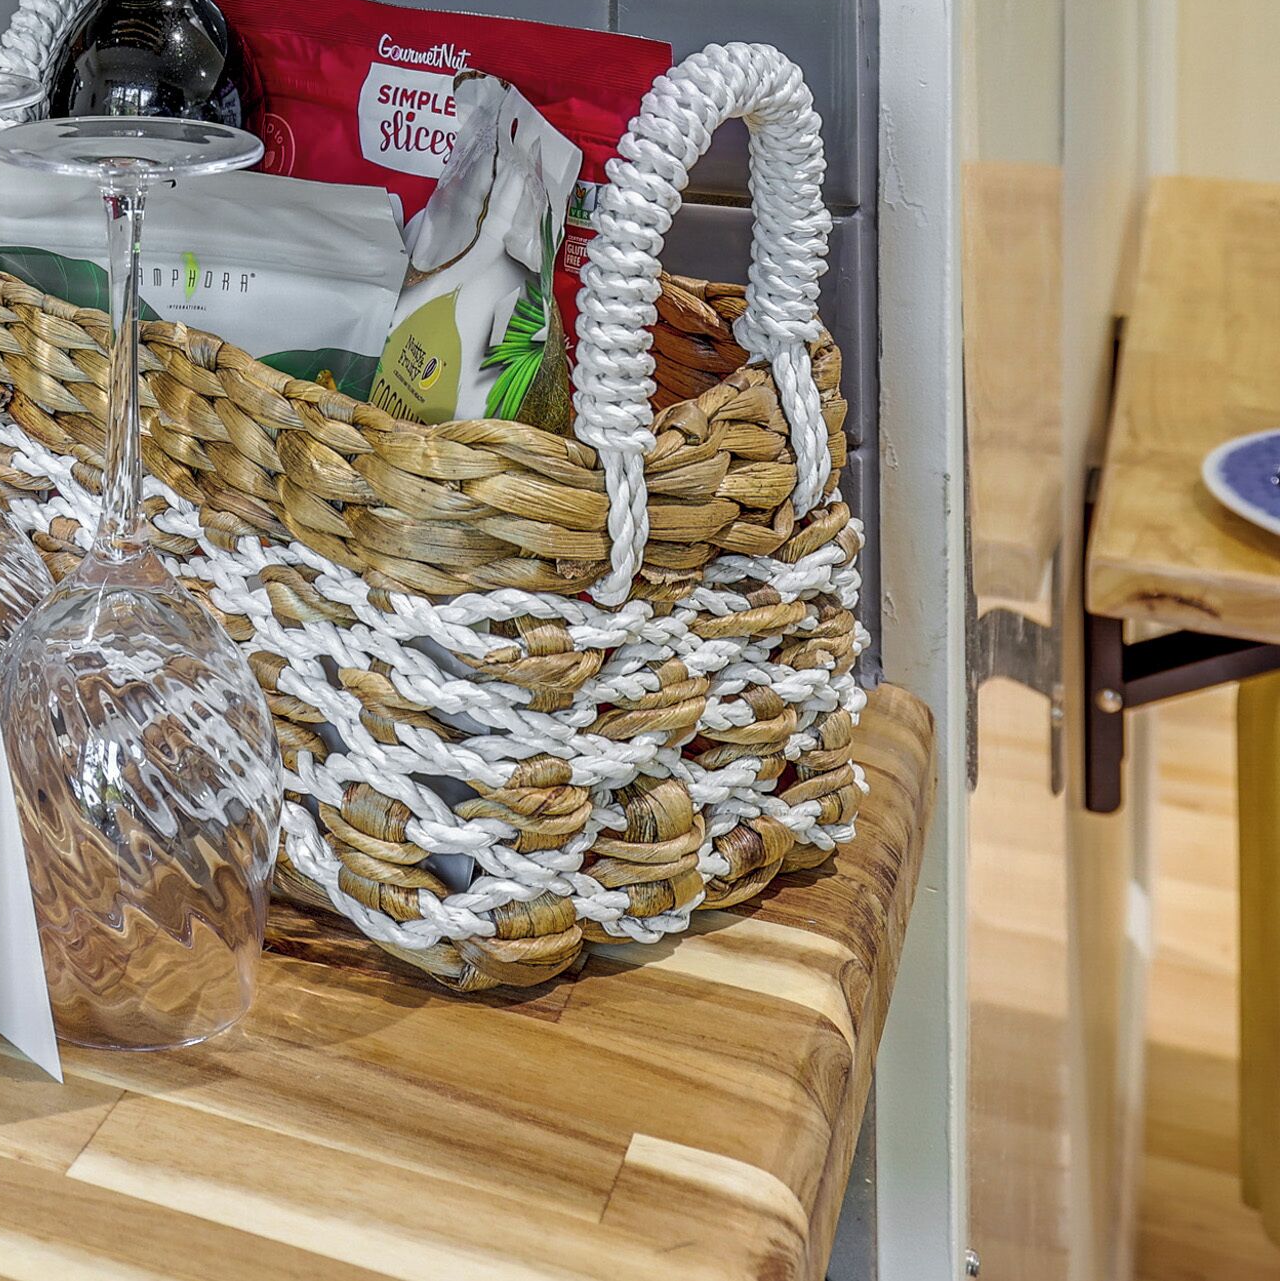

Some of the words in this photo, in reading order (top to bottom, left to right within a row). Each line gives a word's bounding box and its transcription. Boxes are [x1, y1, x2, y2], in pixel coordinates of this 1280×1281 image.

[377, 84, 456, 117] SIMPLE
[380, 110, 457, 164] slices
[565, 254, 581, 267] FREE
[567, 243, 588, 257] GLUTE
[370, 377, 429, 426] COCO
